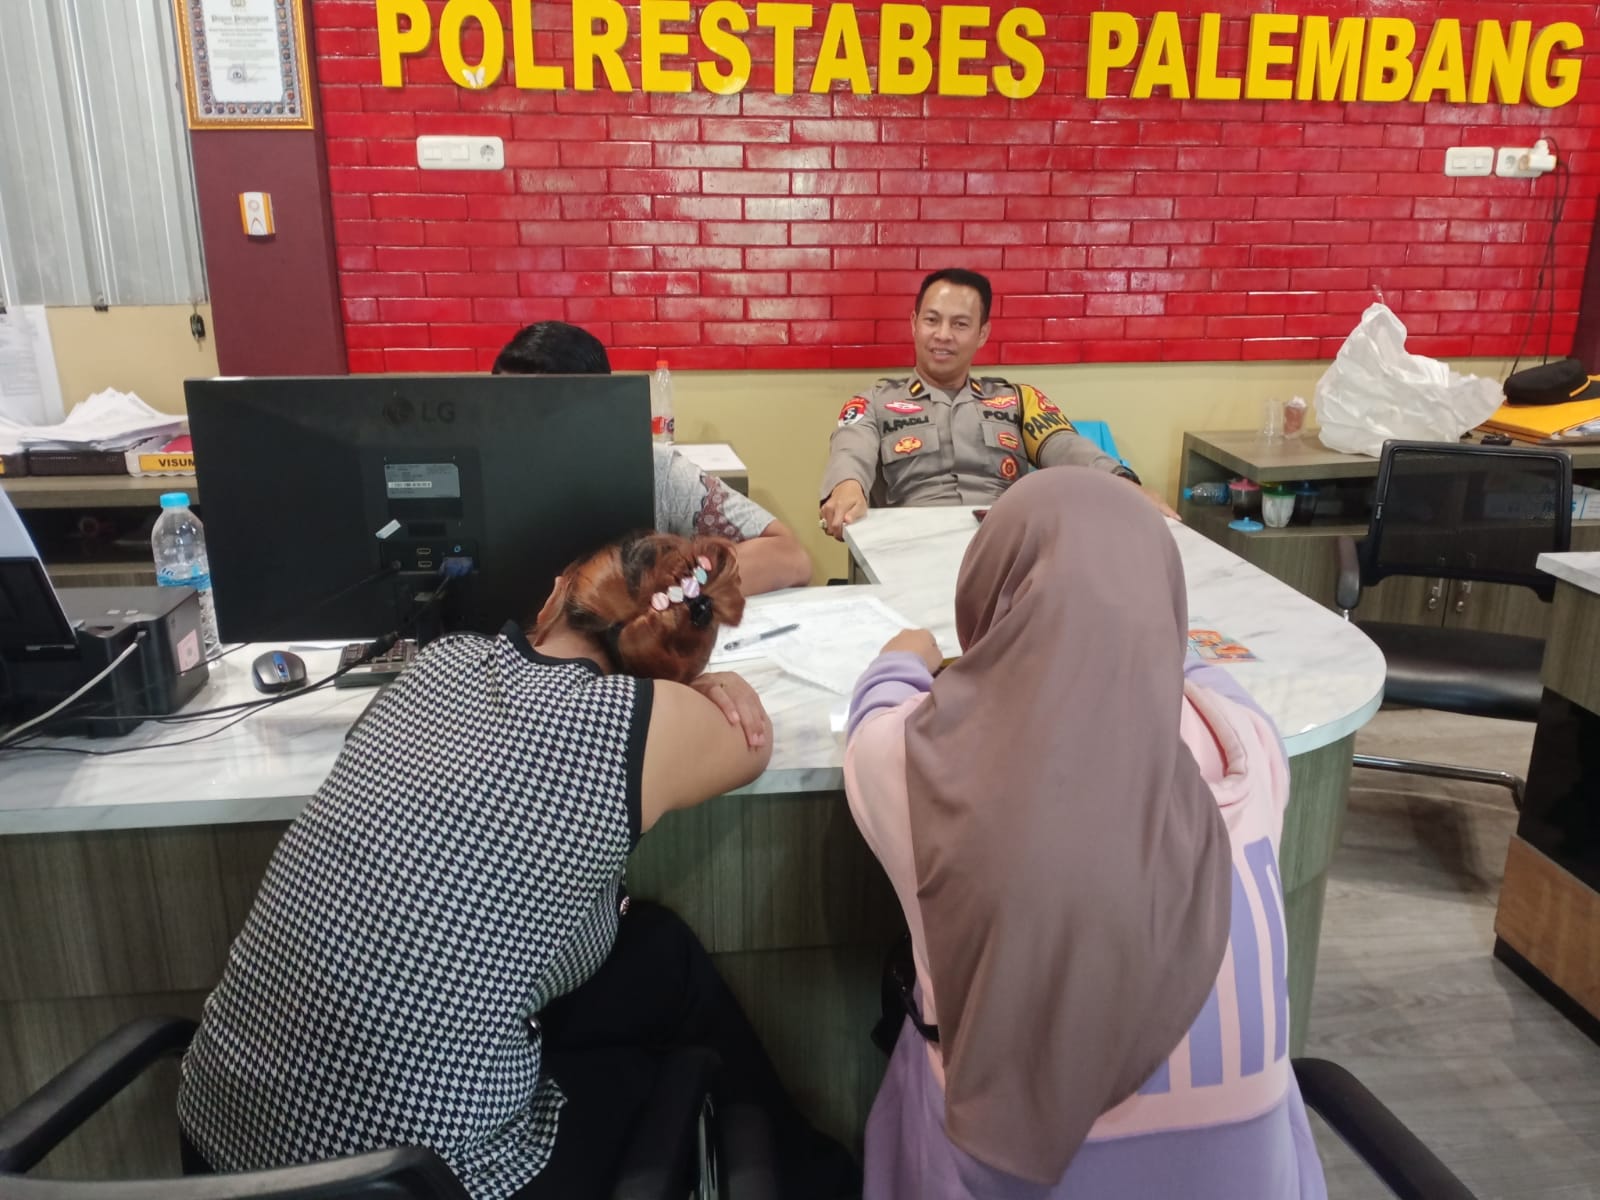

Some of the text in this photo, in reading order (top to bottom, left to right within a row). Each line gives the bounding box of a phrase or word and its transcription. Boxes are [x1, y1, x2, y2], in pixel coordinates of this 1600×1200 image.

[376, 0, 1584, 108] POLRESTABES PALEMBANG
[421, 401, 455, 423] LG
